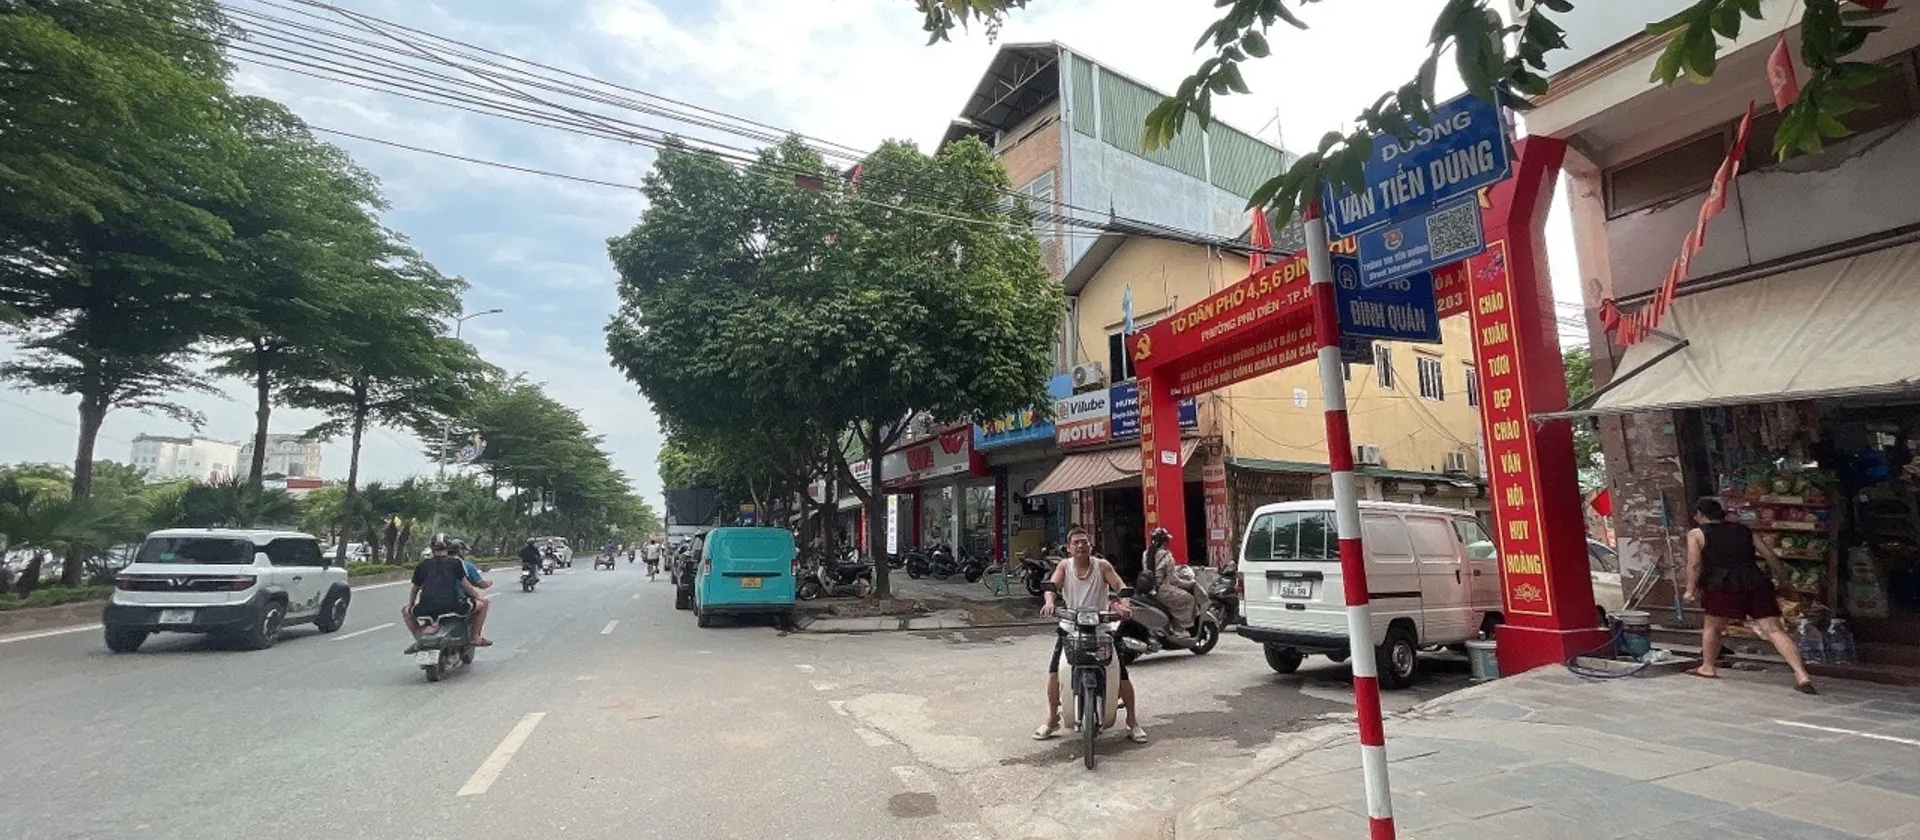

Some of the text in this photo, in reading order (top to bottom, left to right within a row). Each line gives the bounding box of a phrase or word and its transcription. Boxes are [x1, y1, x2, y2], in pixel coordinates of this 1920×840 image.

[1379, 163, 1425, 209] TIẾN
[1430, 139, 1494, 191] DŨNG
[1188, 303, 1214, 328] DÂN
[1283, 256, 1309, 284] ĐÌN
[1350, 296, 1426, 332] ĐÌNH QUÁN
[1059, 421, 1107, 443] MOTUL
[1479, 290, 1541, 575] CHÀO XUÂN TƯƠI ĐẸP CHÀO VẬN HỘI HUY HOÀNG
